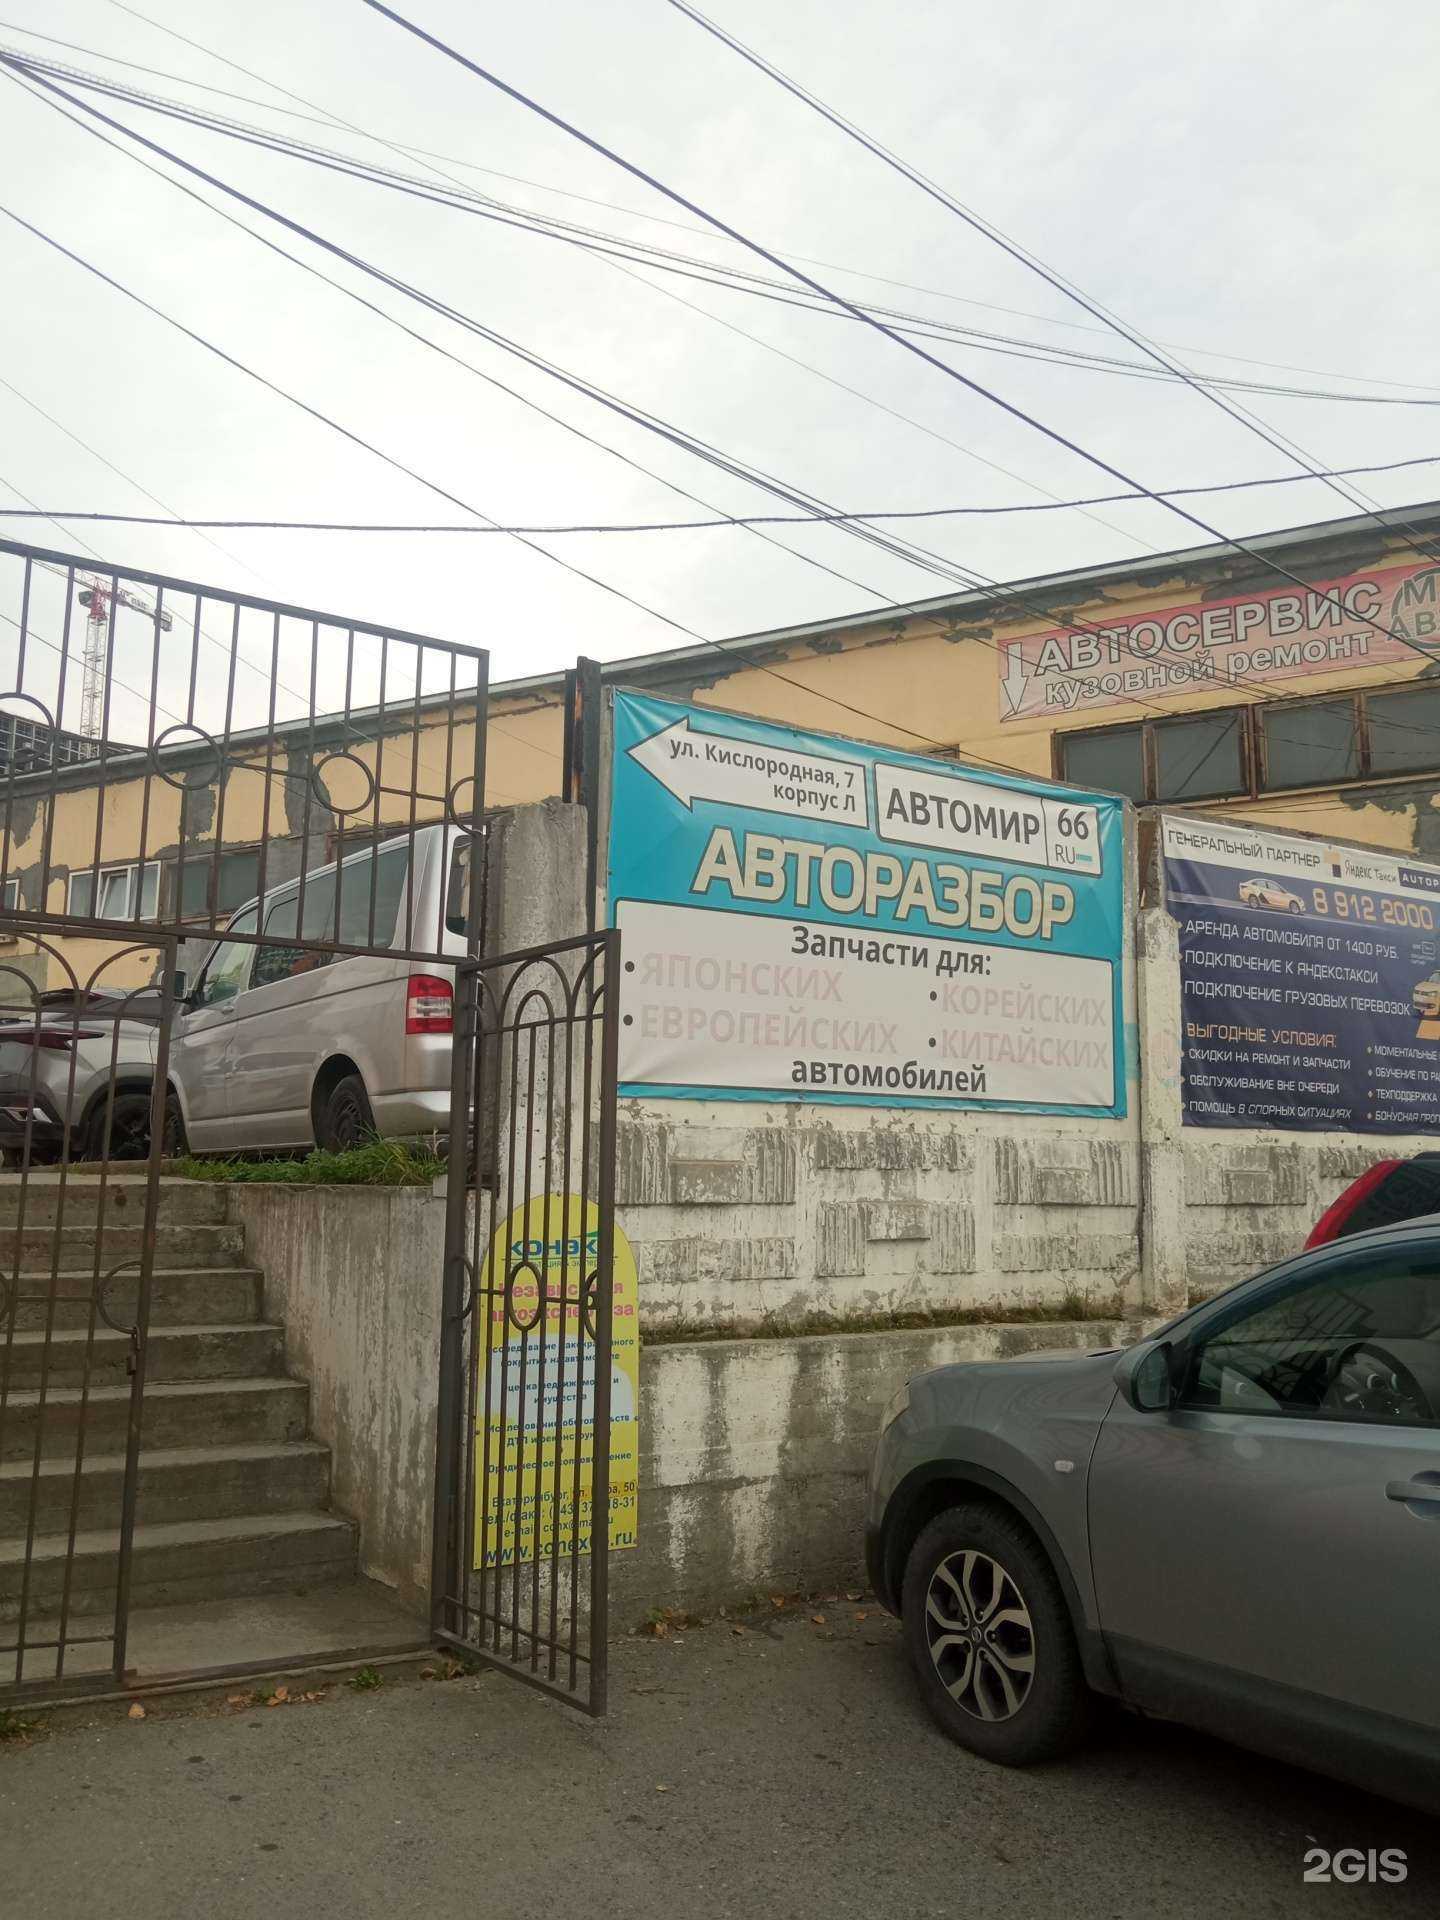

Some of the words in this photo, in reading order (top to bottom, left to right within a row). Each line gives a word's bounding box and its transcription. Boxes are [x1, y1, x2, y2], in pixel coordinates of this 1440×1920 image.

[1034, 581, 1382, 677] АВТОСЕРВИС
[1046, 653, 1214, 709] кузовной
[1228, 630, 1375, 682] ремонт
[670, 738, 699, 760] ул.
[705, 743, 840, 788] Кислородная,
[843, 771, 855, 788] 7
[773, 784, 839, 811] корпус
[842, 794, 856, 812] Л
[886, 788, 1040, 845] АВТОМИР
[1057, 808, 1089, 840] 66
[1055, 844, 1076, 865] RU
[1168, 830, 1263, 859] ГЕНЕРАЛЬНЫЙ
[1266, 847, 1321, 868] ПАРТНЕР
[689, 824, 1075, 941] АВТОРАЗБОР
[1312, 888, 1329, 914] 8
[1333, 890, 1377, 921] 912
[1381, 898, 1434, 930] 2000
[791, 925, 929, 968] Запчасти
[936, 943, 992, 977] для:
[1185, 920, 1240, 940] АРЕНДА
[1243, 926, 1324, 949] АВТОМОБИЛЯ
[1327, 937, 1341, 951] ОТ
[1345, 940, 1373, 956] 1400
[641, 951, 844, 1003] ЯПОНСКИХ
[1185, 950, 1281, 974] ПОДКЛЮЧЕНИЕ
[1285, 961, 1294, 974] К
[942, 982, 1107, 1028] КОРЕЙСКИХ
[1184, 980, 1282, 1003] ПОДКЛЮЧЕНИЕ
[1285, 990, 1348, 1009] ГРУЗОВЫХ
[1351, 997, 1411, 1016] ПЕРЕВОЗОК
[641, 1004, 900, 1056] ЕВРОПЕЙСКИХ
[1186, 1022, 1267, 1043] ВЫГОДНЫЕ
[1272, 1030, 1337, 1048] УСЛОВИЯ:
[941, 1028, 1109, 1071] КИТАЙСКИХ
[1189, 1048, 1232, 1062] СКИДКИ
[1235, 1052, 1249, 1063] НА
[1252, 1053, 1290, 1065] РЕМОНТ
[1293, 1056, 1300, 1066] И
[1302, 1056, 1351, 1069] ЗАПЧАСТИ
[791, 1057, 988, 1094] автомобилей
[1190, 1074, 1274, 1090] ОБСЛУЖИВАНИЕ
[1277, 1080, 1295, 1091] ВНЕ
[1298, 1081, 1340, 1095] ОЧЕРЕДИ
[1375, 1066, 1416, 1080] ОБУЧЕНИЕ
[1189, 1101, 1236, 1114] ПОМОЩЬ
[1248, 1104, 1296, 1117] СПОРНЫХ
[1297, 1106, 1352, 1119] СИТУАЦИЯХ
